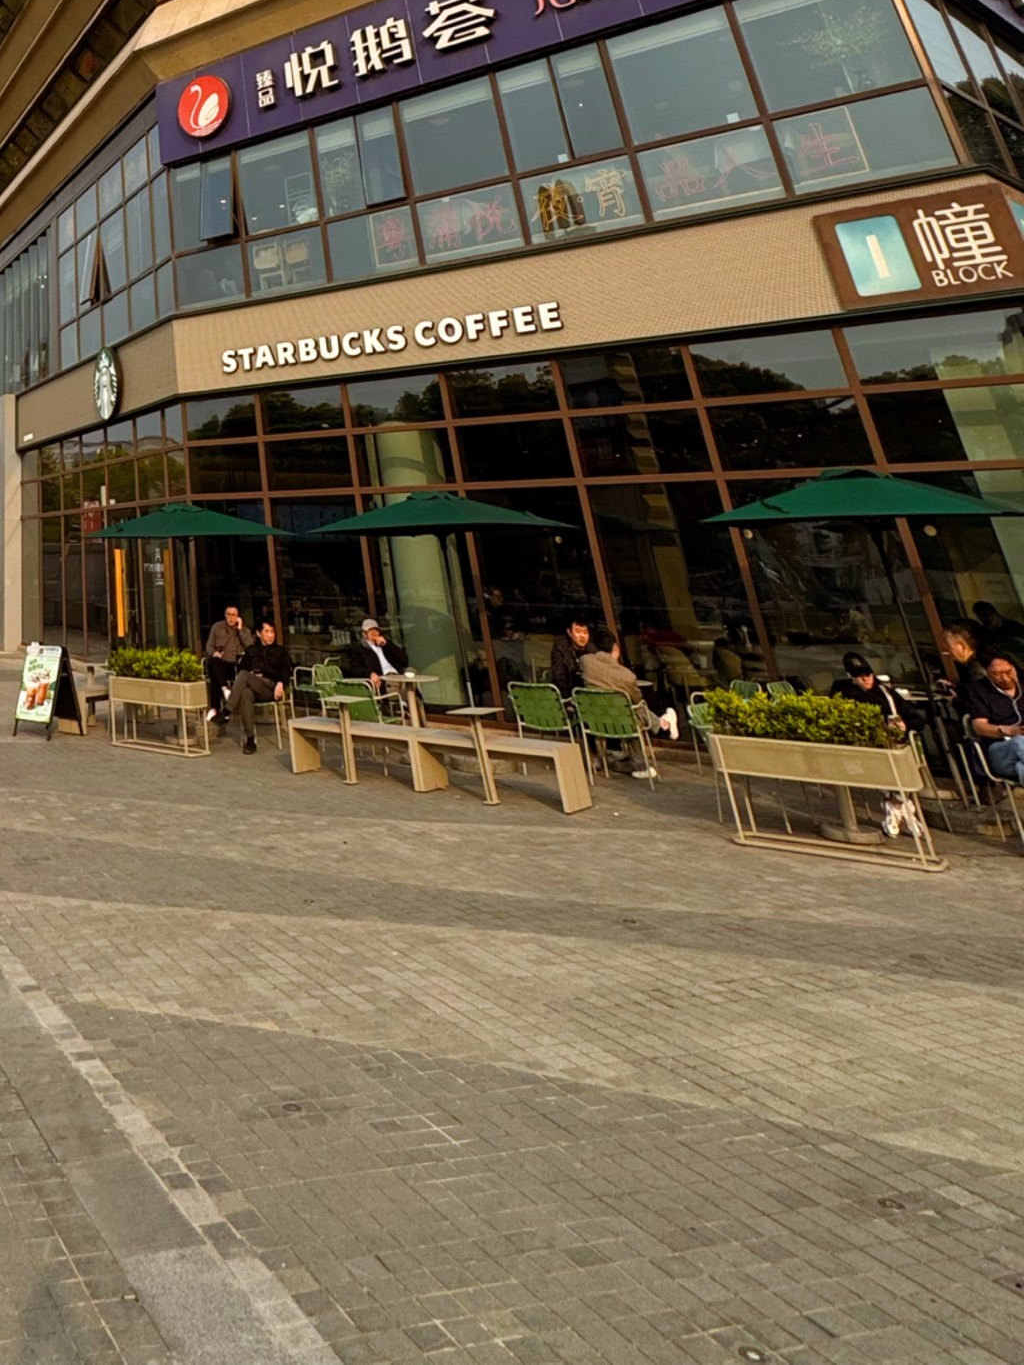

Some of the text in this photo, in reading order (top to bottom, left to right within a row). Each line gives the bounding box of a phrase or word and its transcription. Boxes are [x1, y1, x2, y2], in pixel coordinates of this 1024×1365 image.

[912, 201, 1009, 271] 幢
[931, 260, 1014, 287] BLOCK
[221, 301, 563, 374] STARBUCKS COFFEE
